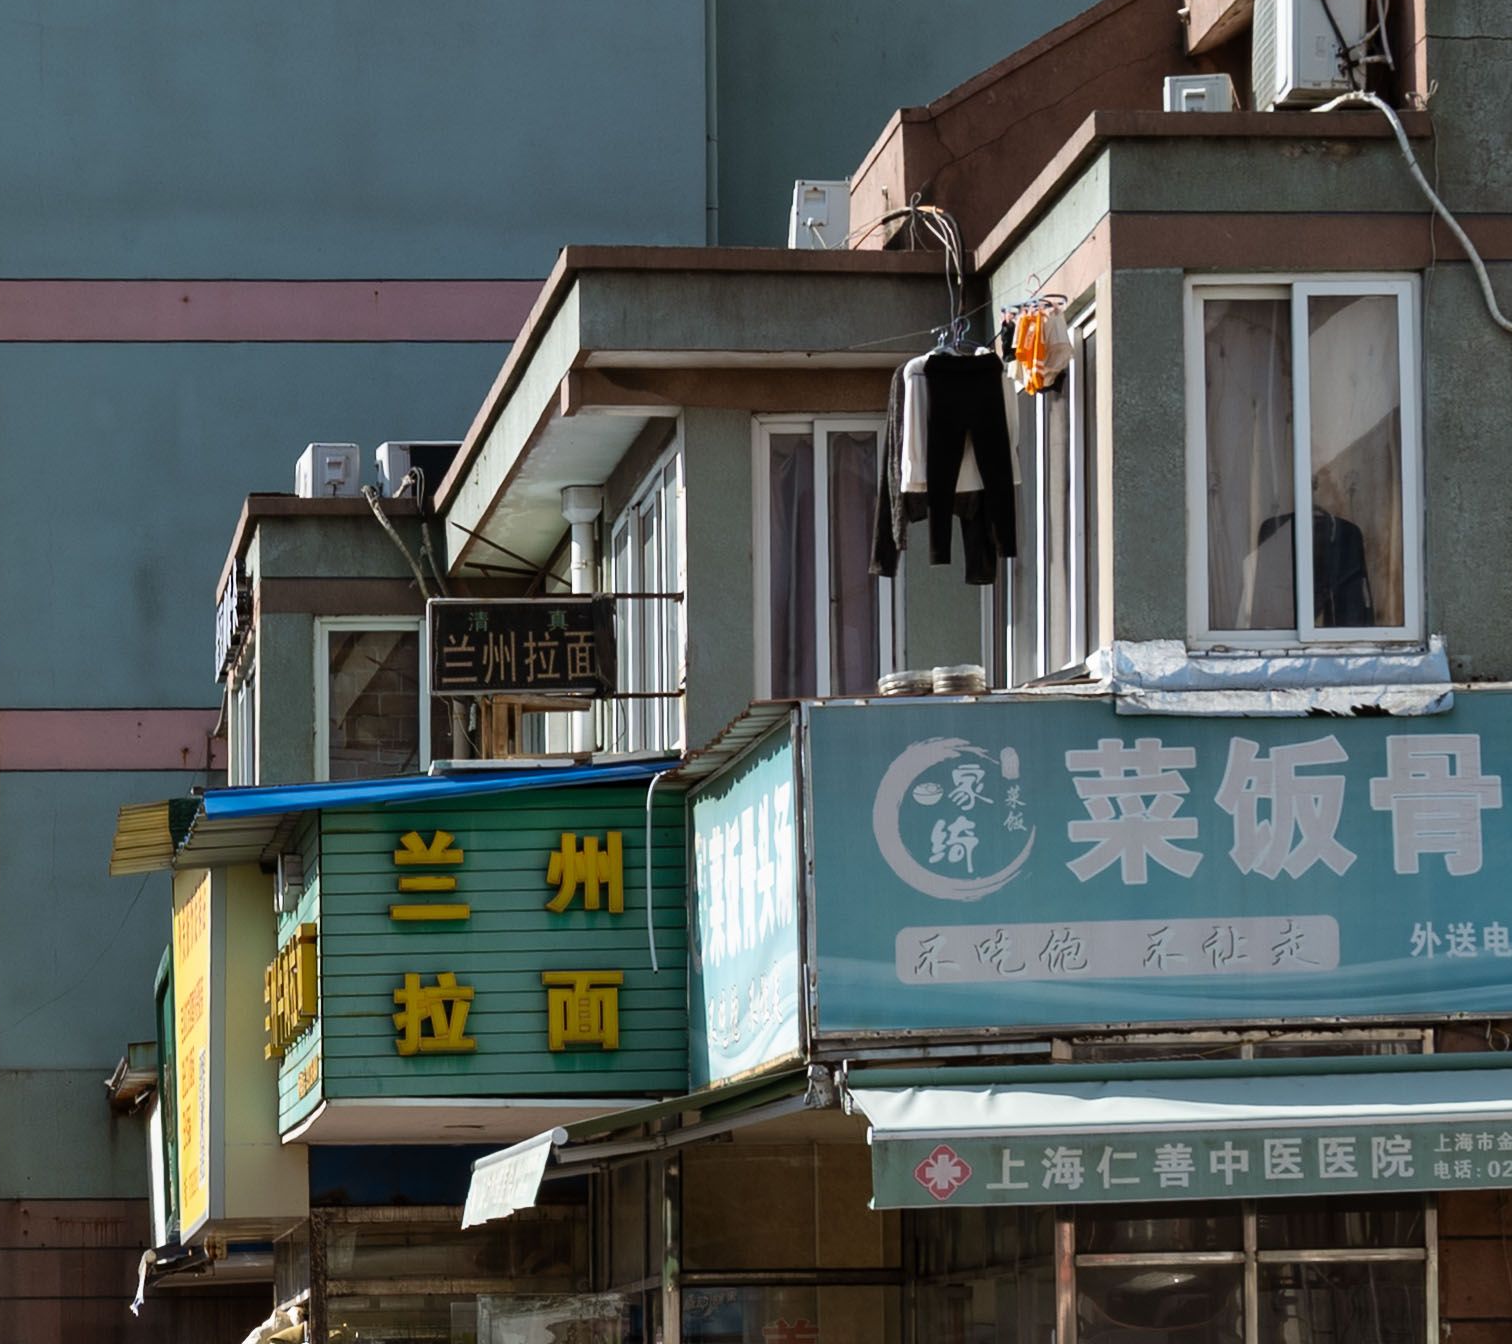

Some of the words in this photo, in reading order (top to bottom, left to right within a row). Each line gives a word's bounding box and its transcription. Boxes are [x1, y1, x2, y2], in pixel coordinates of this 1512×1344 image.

[469, 609, 569, 632] 清真
[442, 630, 597, 684] 兰州拉面
[1003, 784, 1028, 832] 菜饭
[389, 829, 625, 921] 兰州
[914, 927, 1090, 977] 不吃饱
[392, 968, 625, 1056] 拉面
[985, 1135, 1415, 1192] 上海仁善中医医院
